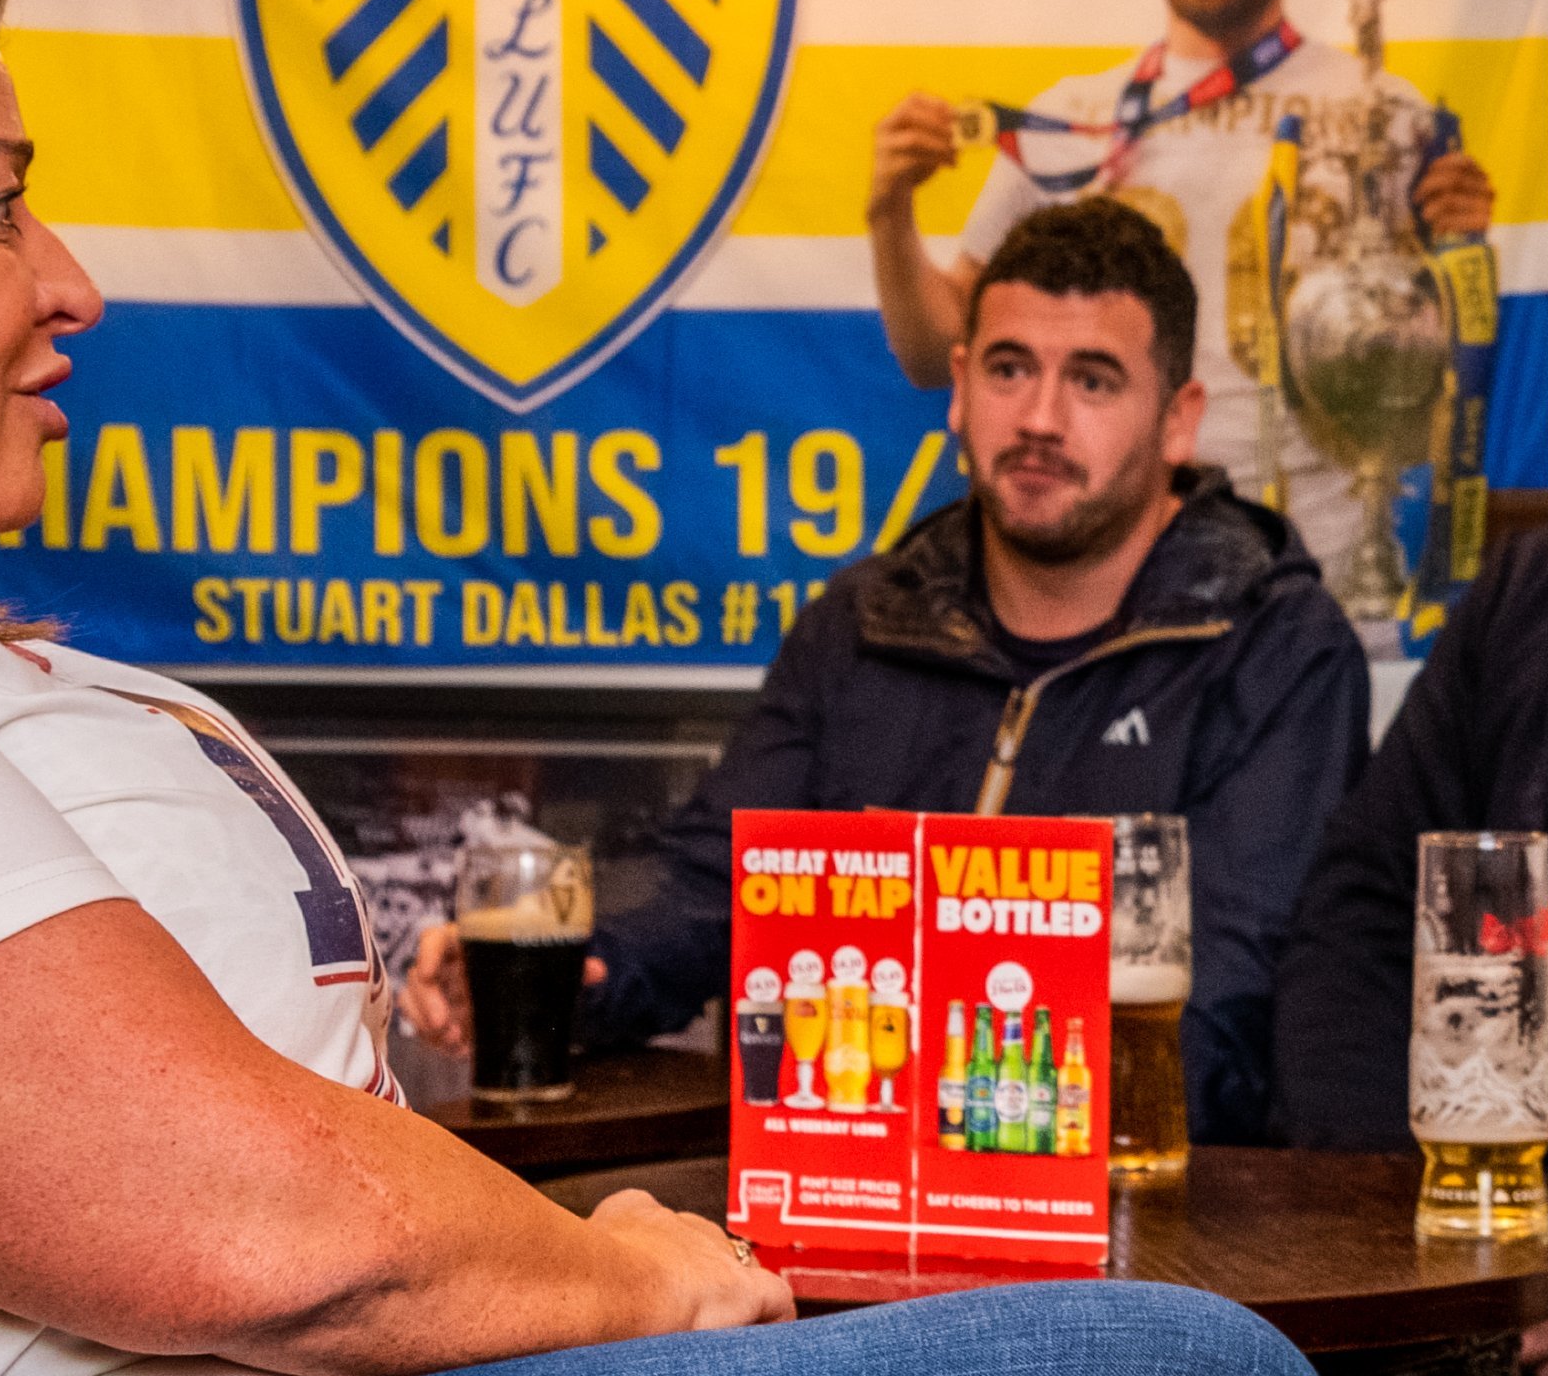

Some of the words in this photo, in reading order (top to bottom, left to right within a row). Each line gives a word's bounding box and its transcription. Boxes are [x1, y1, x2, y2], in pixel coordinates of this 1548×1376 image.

[194, 577, 443, 645] STUART
[462, 579, 701, 648] DALLAS
[720, 580, 829, 646] #1
[742, 848, 827, 876] GREAT
[833, 850, 911, 878] VALUE
[929, 845, 1102, 902] VALUE
[740, 873, 817, 916] ON
[827, 875, 913, 919] TAP
[936, 896, 1104, 938] BOTTLED
[858, 1179, 901, 1196] PRICES
[926, 1193, 950, 1208] SAY
[952, 1193, 1001, 1212] CHEERS
[1002, 1197, 1022, 1212] TO
[1023, 1198, 1049, 1214] THE
[1050, 1200, 1095, 1216] BEERS
